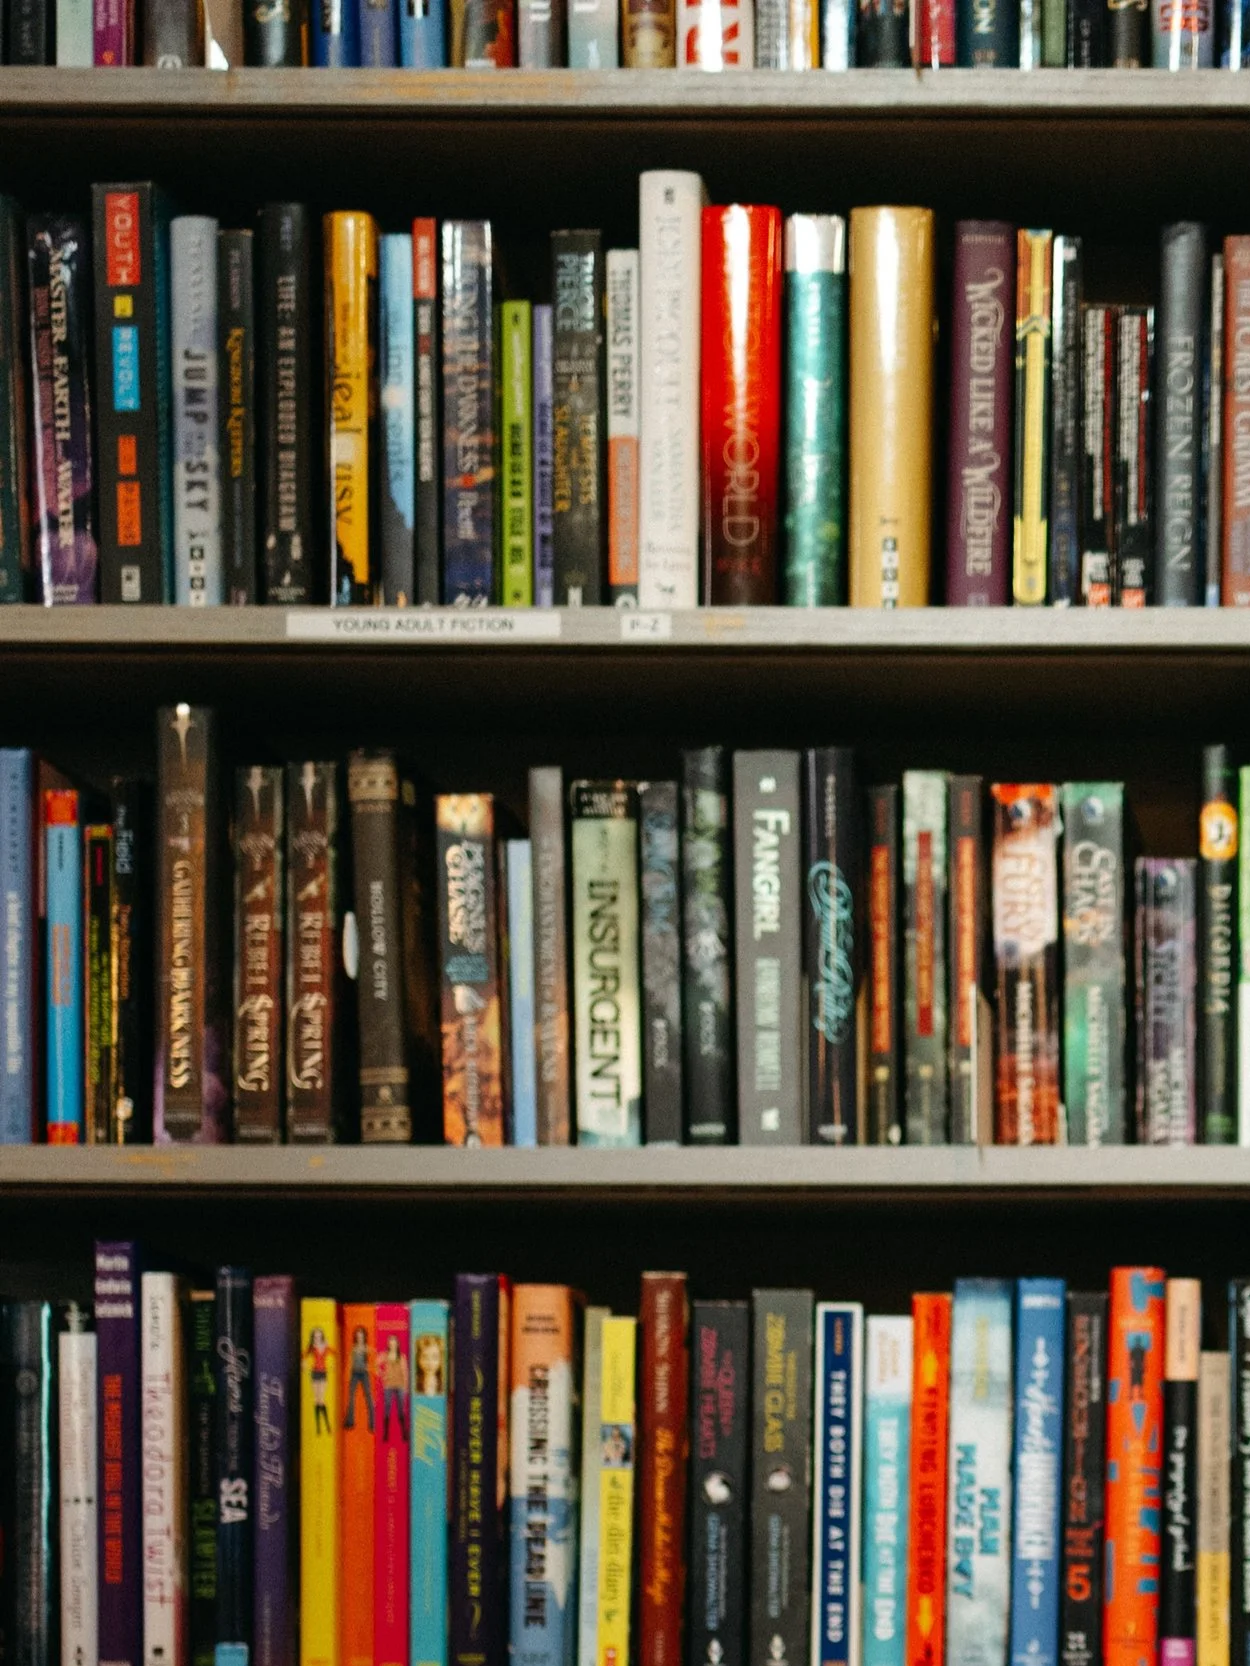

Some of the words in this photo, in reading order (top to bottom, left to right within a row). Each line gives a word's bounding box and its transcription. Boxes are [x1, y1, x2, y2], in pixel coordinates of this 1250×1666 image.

[610, 268, 632, 346] THOMAS
[964, 267, 1005, 373] WICKED
[183, 349, 208, 424] JUMP
[612, 354, 633, 418] PERRY
[967, 377, 996, 431] LIKE
[1166, 334, 1194, 458] FROZEN
[721, 403, 759, 547] WORLD
[966, 437, 994, 456] A
[185, 461, 208, 513] SKY
[961, 455, 1001, 577] WILDFIRE
[1166, 472, 1192, 572] REIGN
[332, 616, 391, 632] YOUNG
[395, 616, 445, 632] ADULT
[451, 616, 514, 632] FICTION
[753, 809, 790, 940] FANGIRL
[587, 879, 621, 1107] INSURGENT
[220, 1477, 247, 1524] SEA
